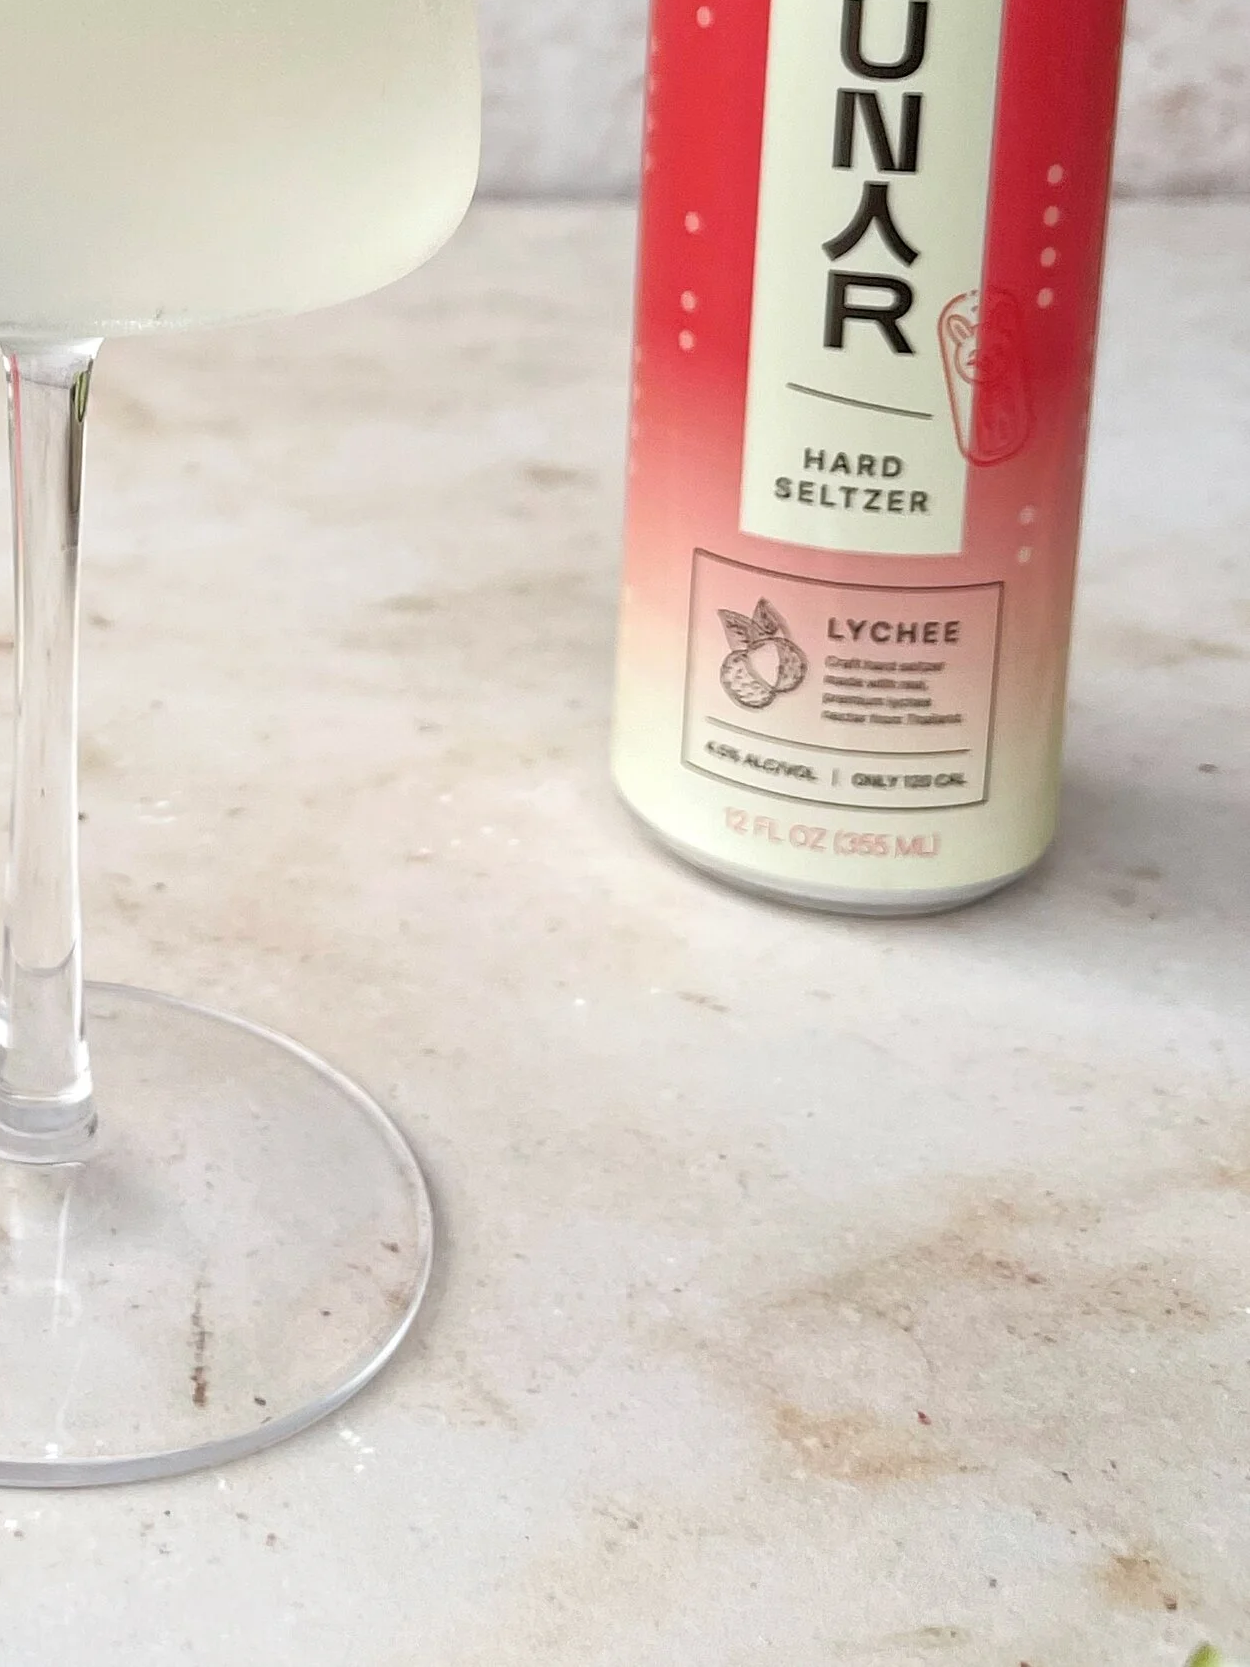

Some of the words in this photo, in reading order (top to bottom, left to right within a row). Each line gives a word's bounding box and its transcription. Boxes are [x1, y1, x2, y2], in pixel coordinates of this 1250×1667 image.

[803, 447, 903, 478] HARD
[774, 476, 929, 514] SELTZER
[827, 617, 961, 643] LYCHEE
[724, 806, 750, 834] 12
[752, 815, 785, 843] FL
[789, 824, 828, 851] OZ
